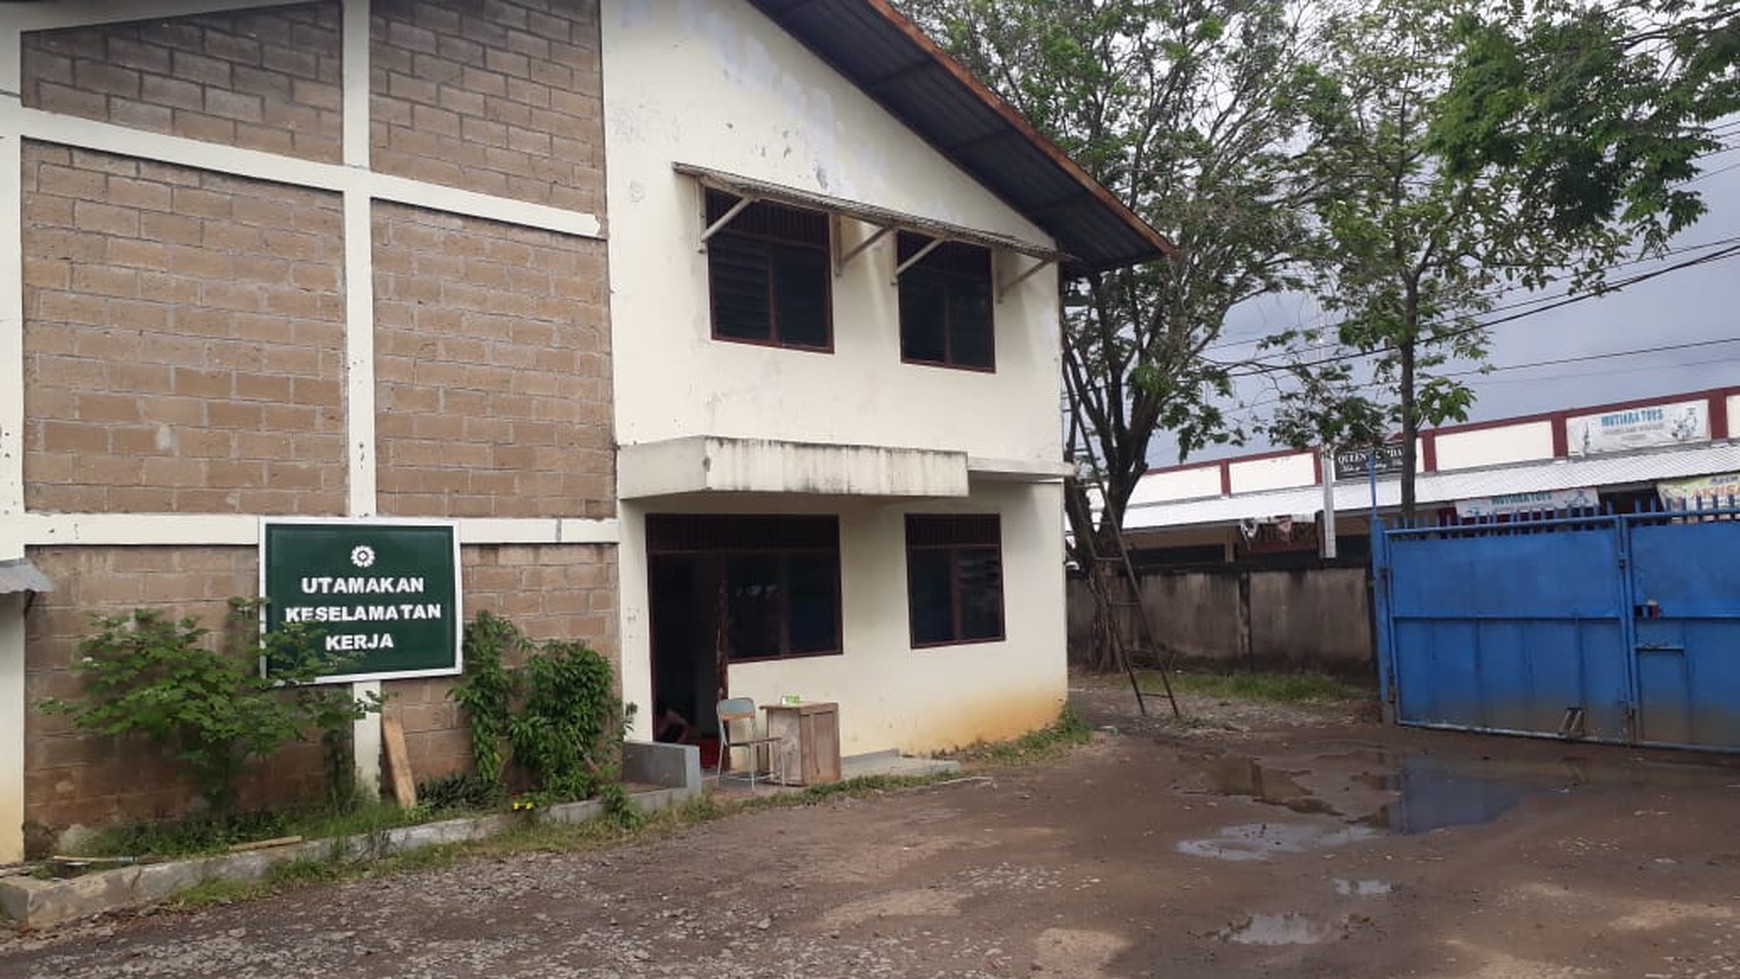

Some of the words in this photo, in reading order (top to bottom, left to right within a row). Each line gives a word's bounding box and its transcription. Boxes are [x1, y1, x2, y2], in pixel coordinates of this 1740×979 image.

[302, 577, 424, 594] UTAMAKAN
[286, 604, 441, 622] KESELAMATAN
[325, 633, 394, 651] KERJA
